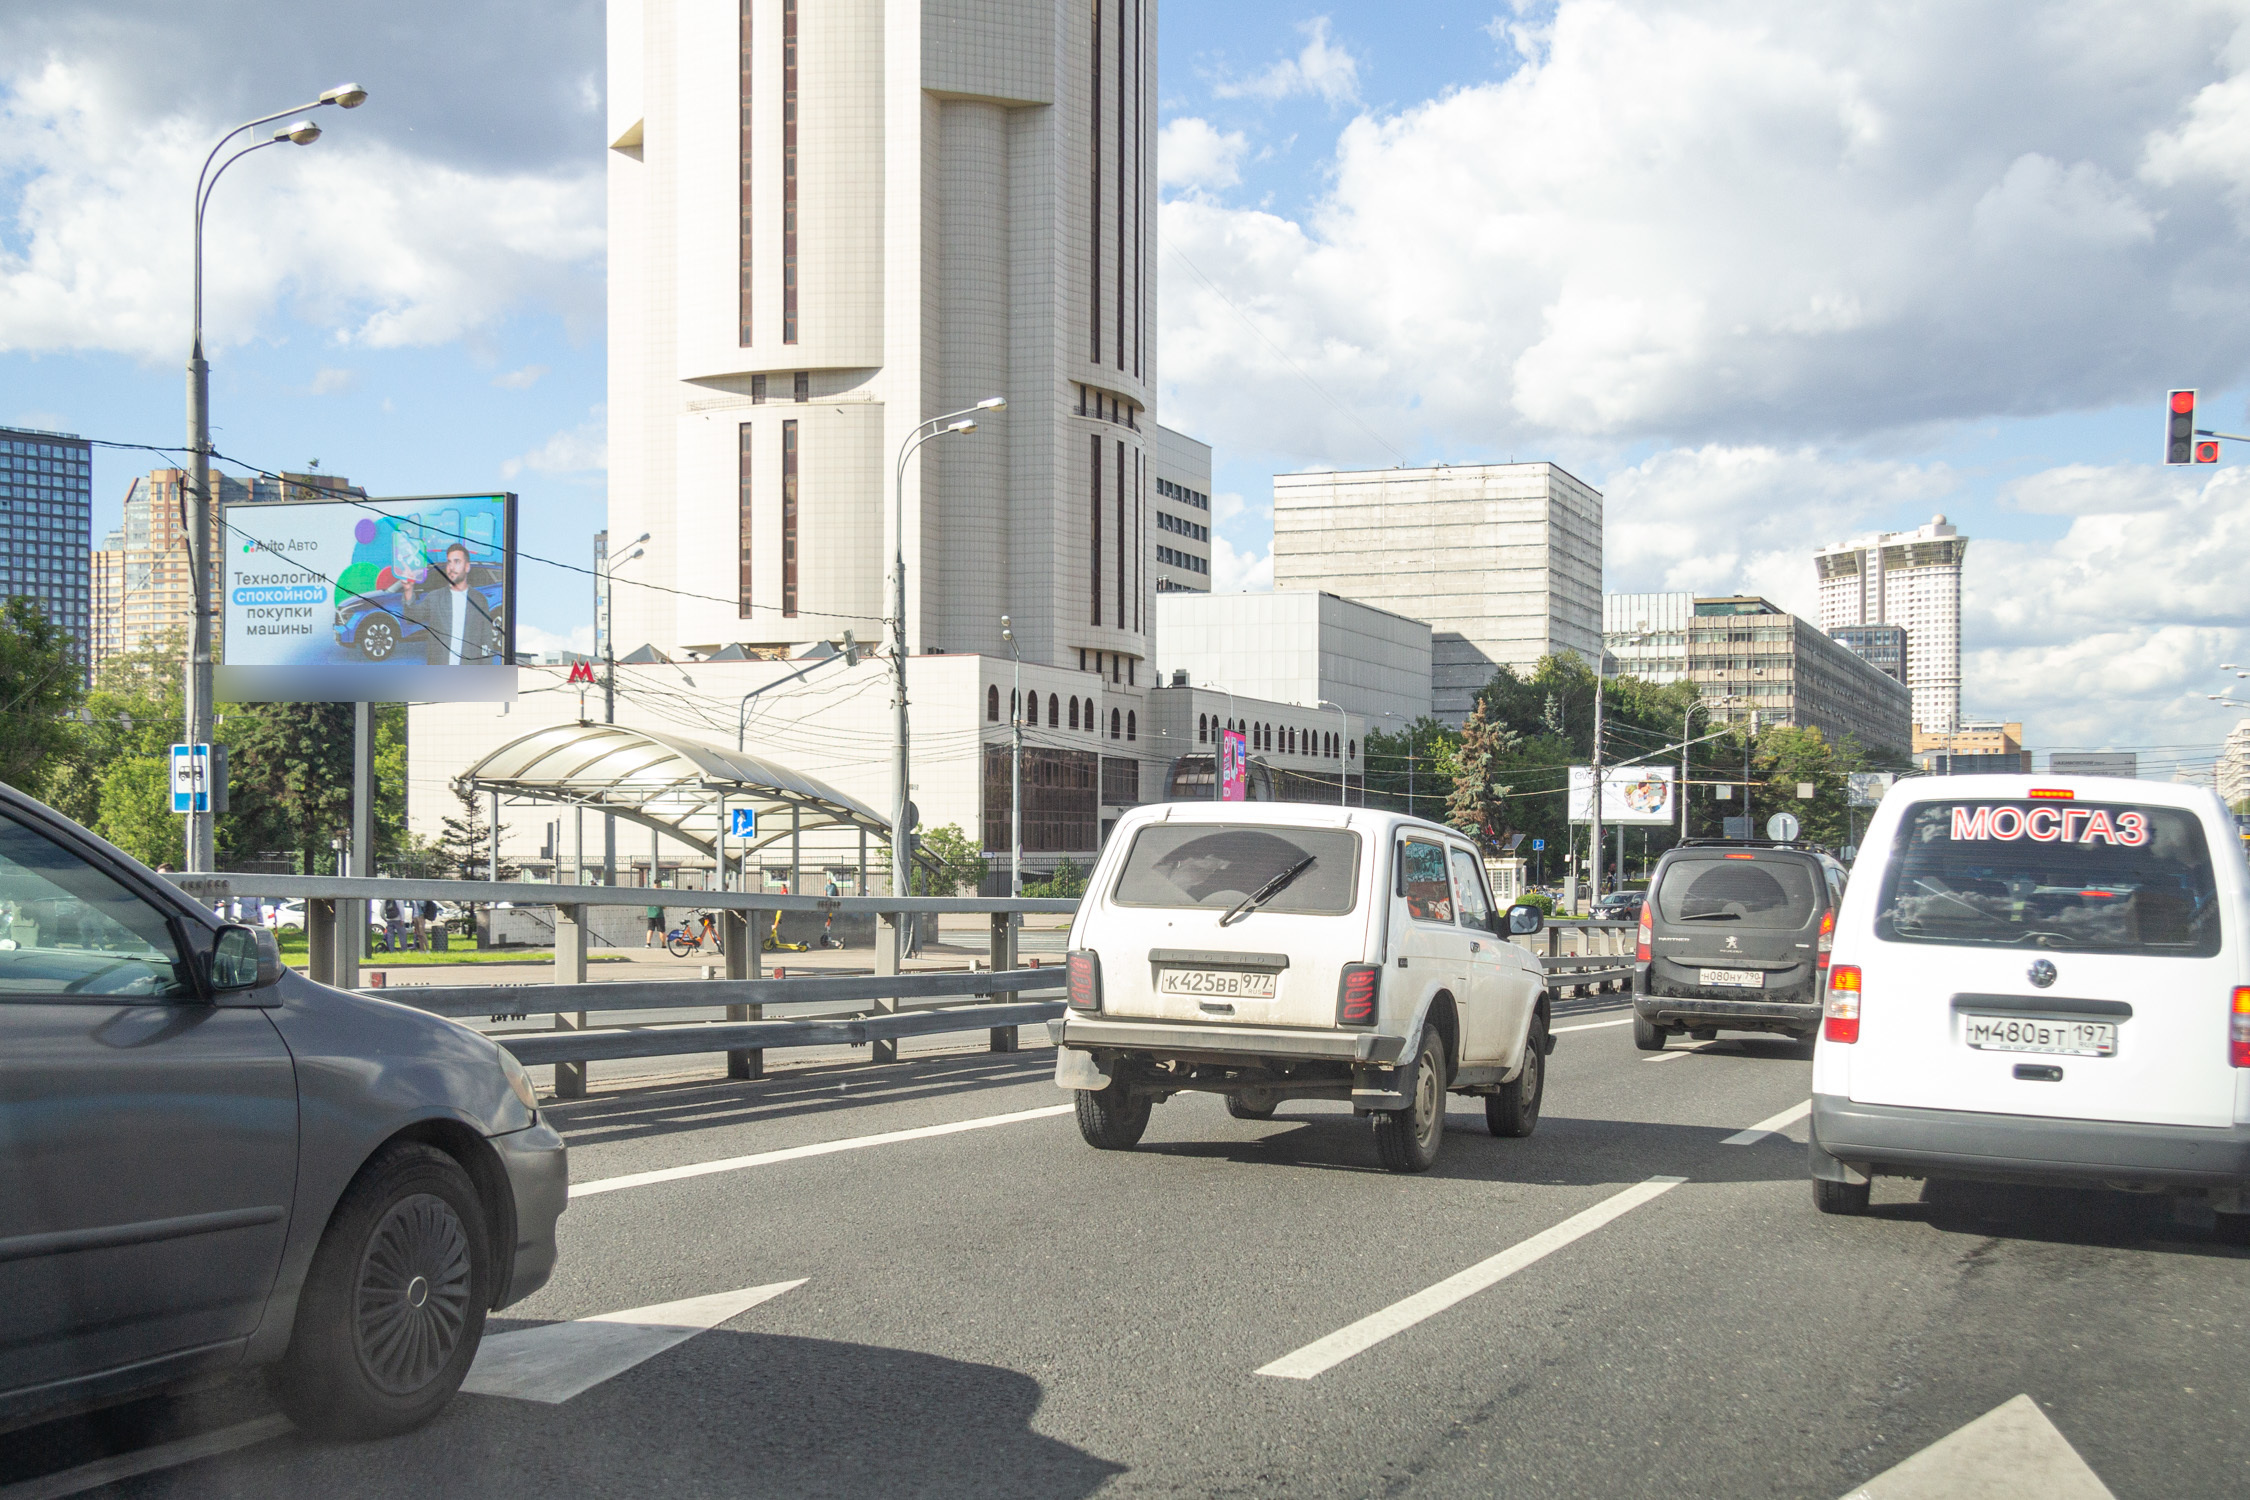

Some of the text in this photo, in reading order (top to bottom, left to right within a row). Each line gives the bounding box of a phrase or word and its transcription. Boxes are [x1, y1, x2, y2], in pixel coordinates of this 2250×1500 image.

[255, 539, 318, 552] Avito Авто
[234, 571, 326, 585] Технологии
[236, 586, 323, 602] спокойной
[247, 607, 313, 621] покупки
[247, 624, 313, 635] машины
[1950, 806, 2149, 847] МОСГАЗ
[1242, 974, 1271, 989] 977
[2073, 1025, 2107, 1041] 197
